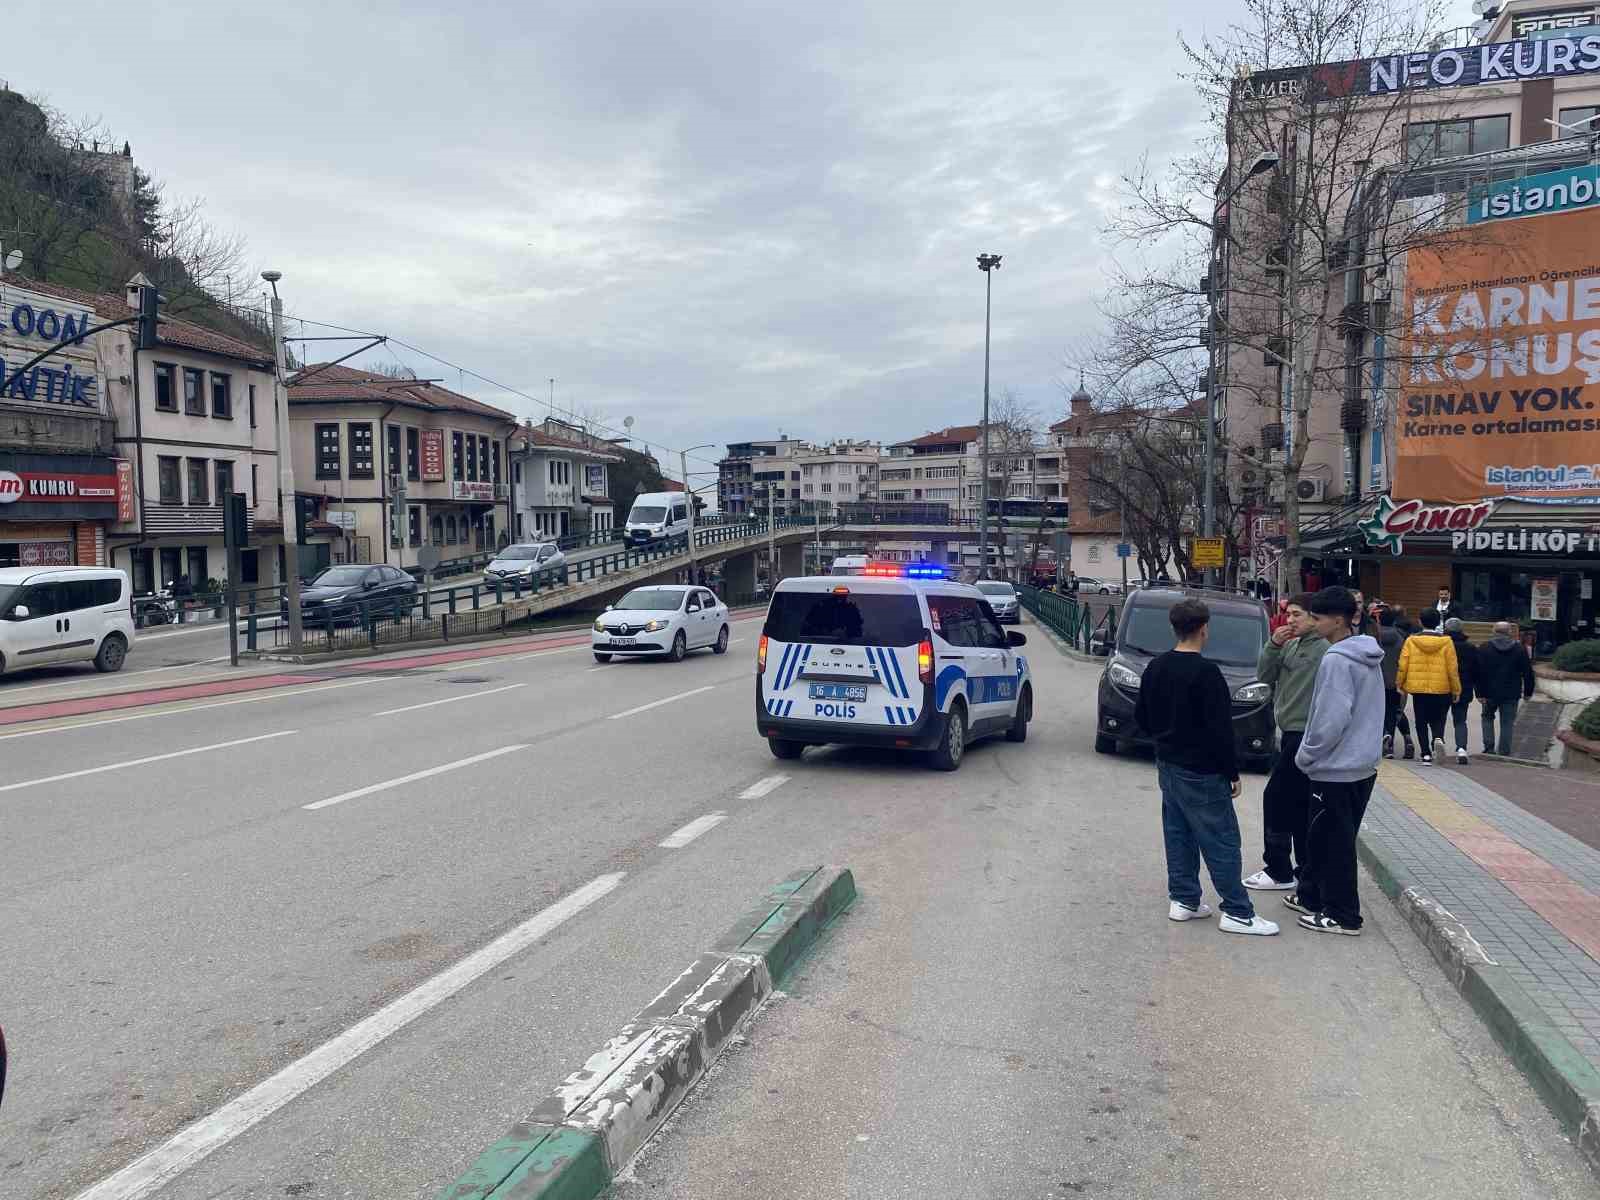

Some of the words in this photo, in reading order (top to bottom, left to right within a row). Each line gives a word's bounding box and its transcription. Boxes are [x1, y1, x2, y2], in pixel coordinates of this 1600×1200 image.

[1480, 175, 1600, 218] istanb
[1471, 274, 1536, 290] Hazırlanan
[1411, 277, 1600, 335] KARNE
[0, 303, 88, 344] OON
[1406, 390, 1502, 417] SINAV
[1509, 386, 1595, 412] YOK.
[1404, 421, 1466, 437] Karne
[1488, 466, 1565, 483] istanbul
[30, 479, 75, 495] KUMRU
[1531, 529, 1600, 553] KÖFT
[815, 701, 856, 719] POLİS
